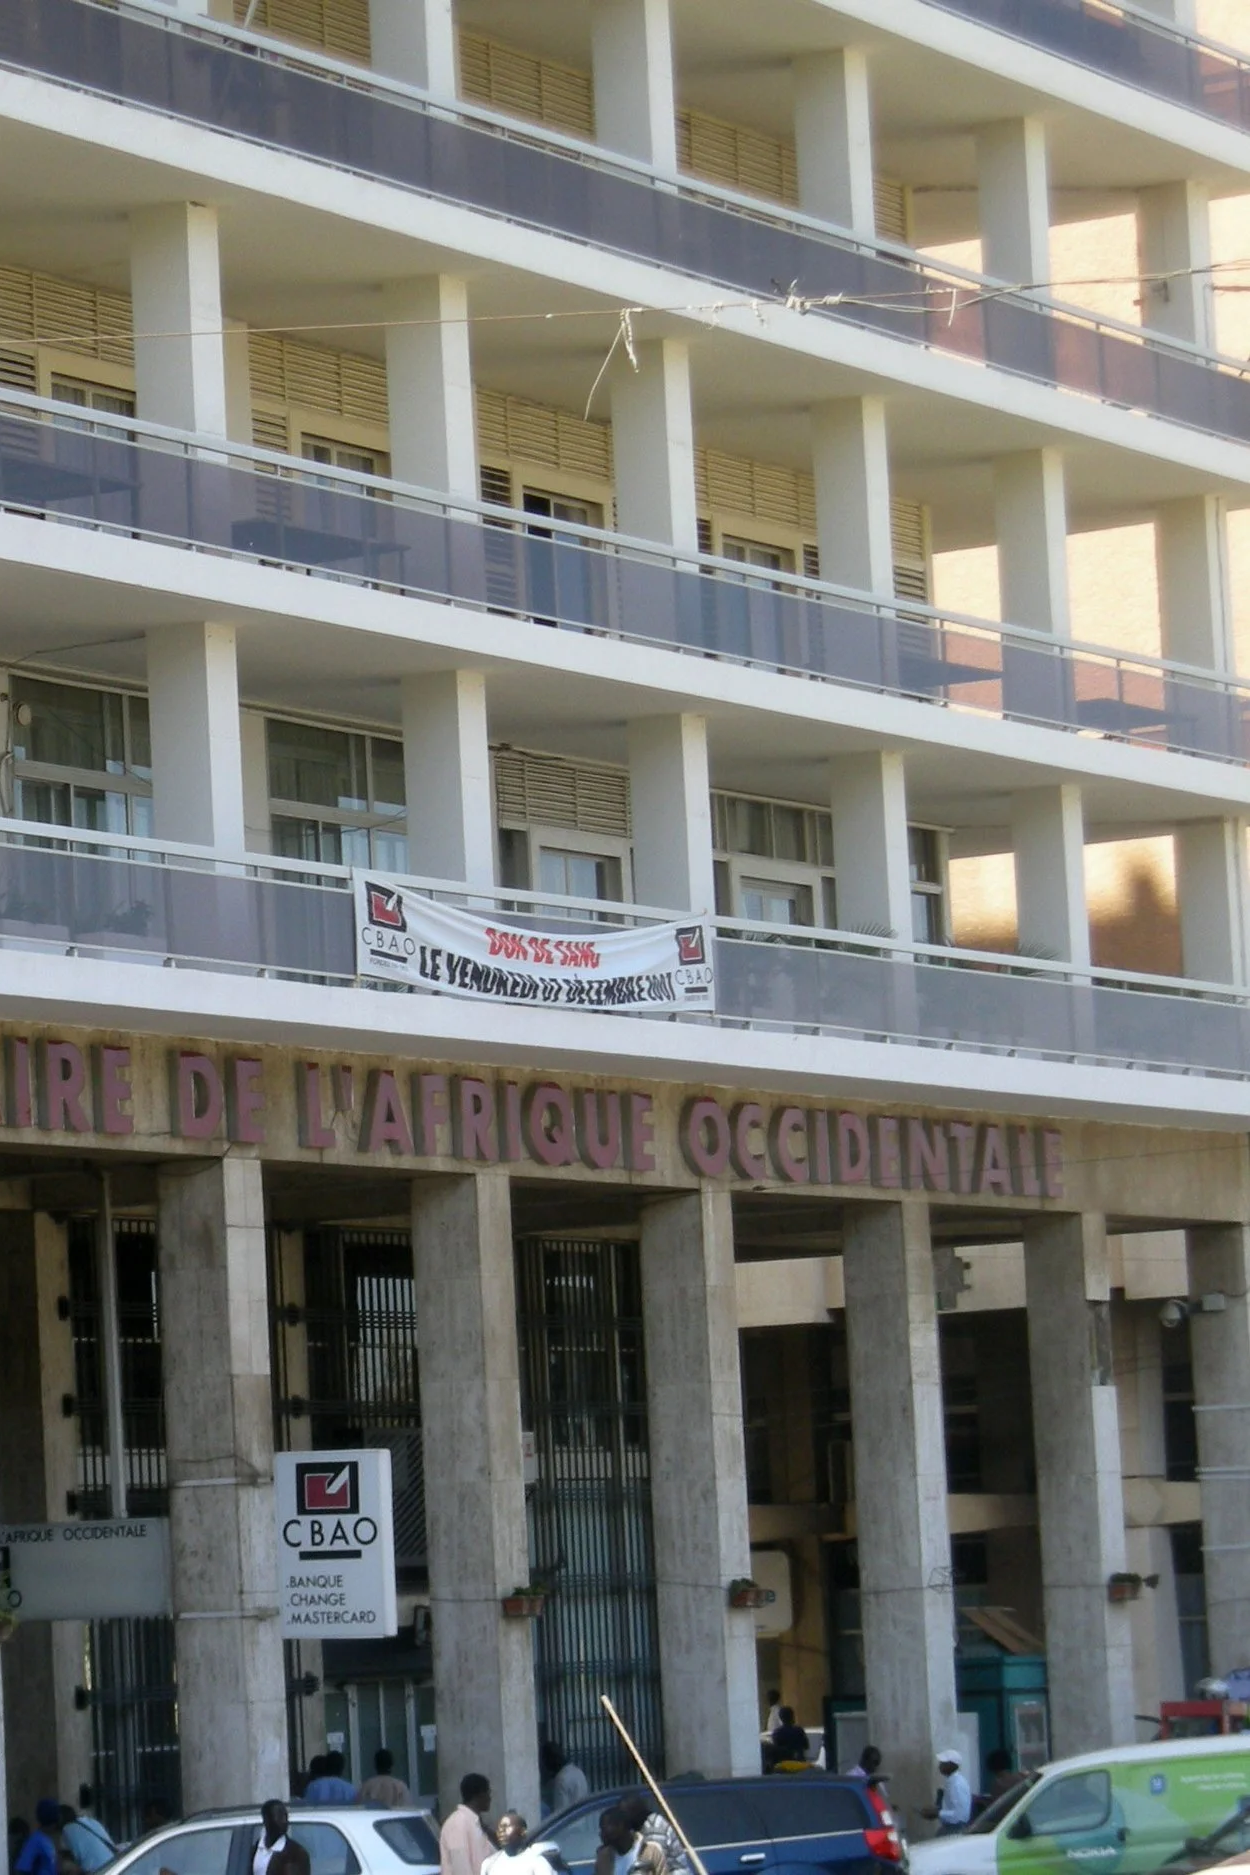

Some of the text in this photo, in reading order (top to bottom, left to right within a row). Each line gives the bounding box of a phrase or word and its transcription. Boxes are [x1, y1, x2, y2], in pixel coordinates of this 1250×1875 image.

[362, 927, 416, 955] CBAO
[485, 927, 601, 969] DON DE SANG
[419, 945, 442, 982] LE
[446, 952, 539, 1000] VENDREDI
[675, 967, 713, 986] CBAO
[174, 1050, 265, 1145] DE
[300, 1061, 656, 1172] L'AFRIQUE
[682, 1095, 1065, 1199] OCCIDENTALE
[63, 1524, 147, 1541] OCCIDENTALE
[282, 1517, 378, 1548] CBAO
